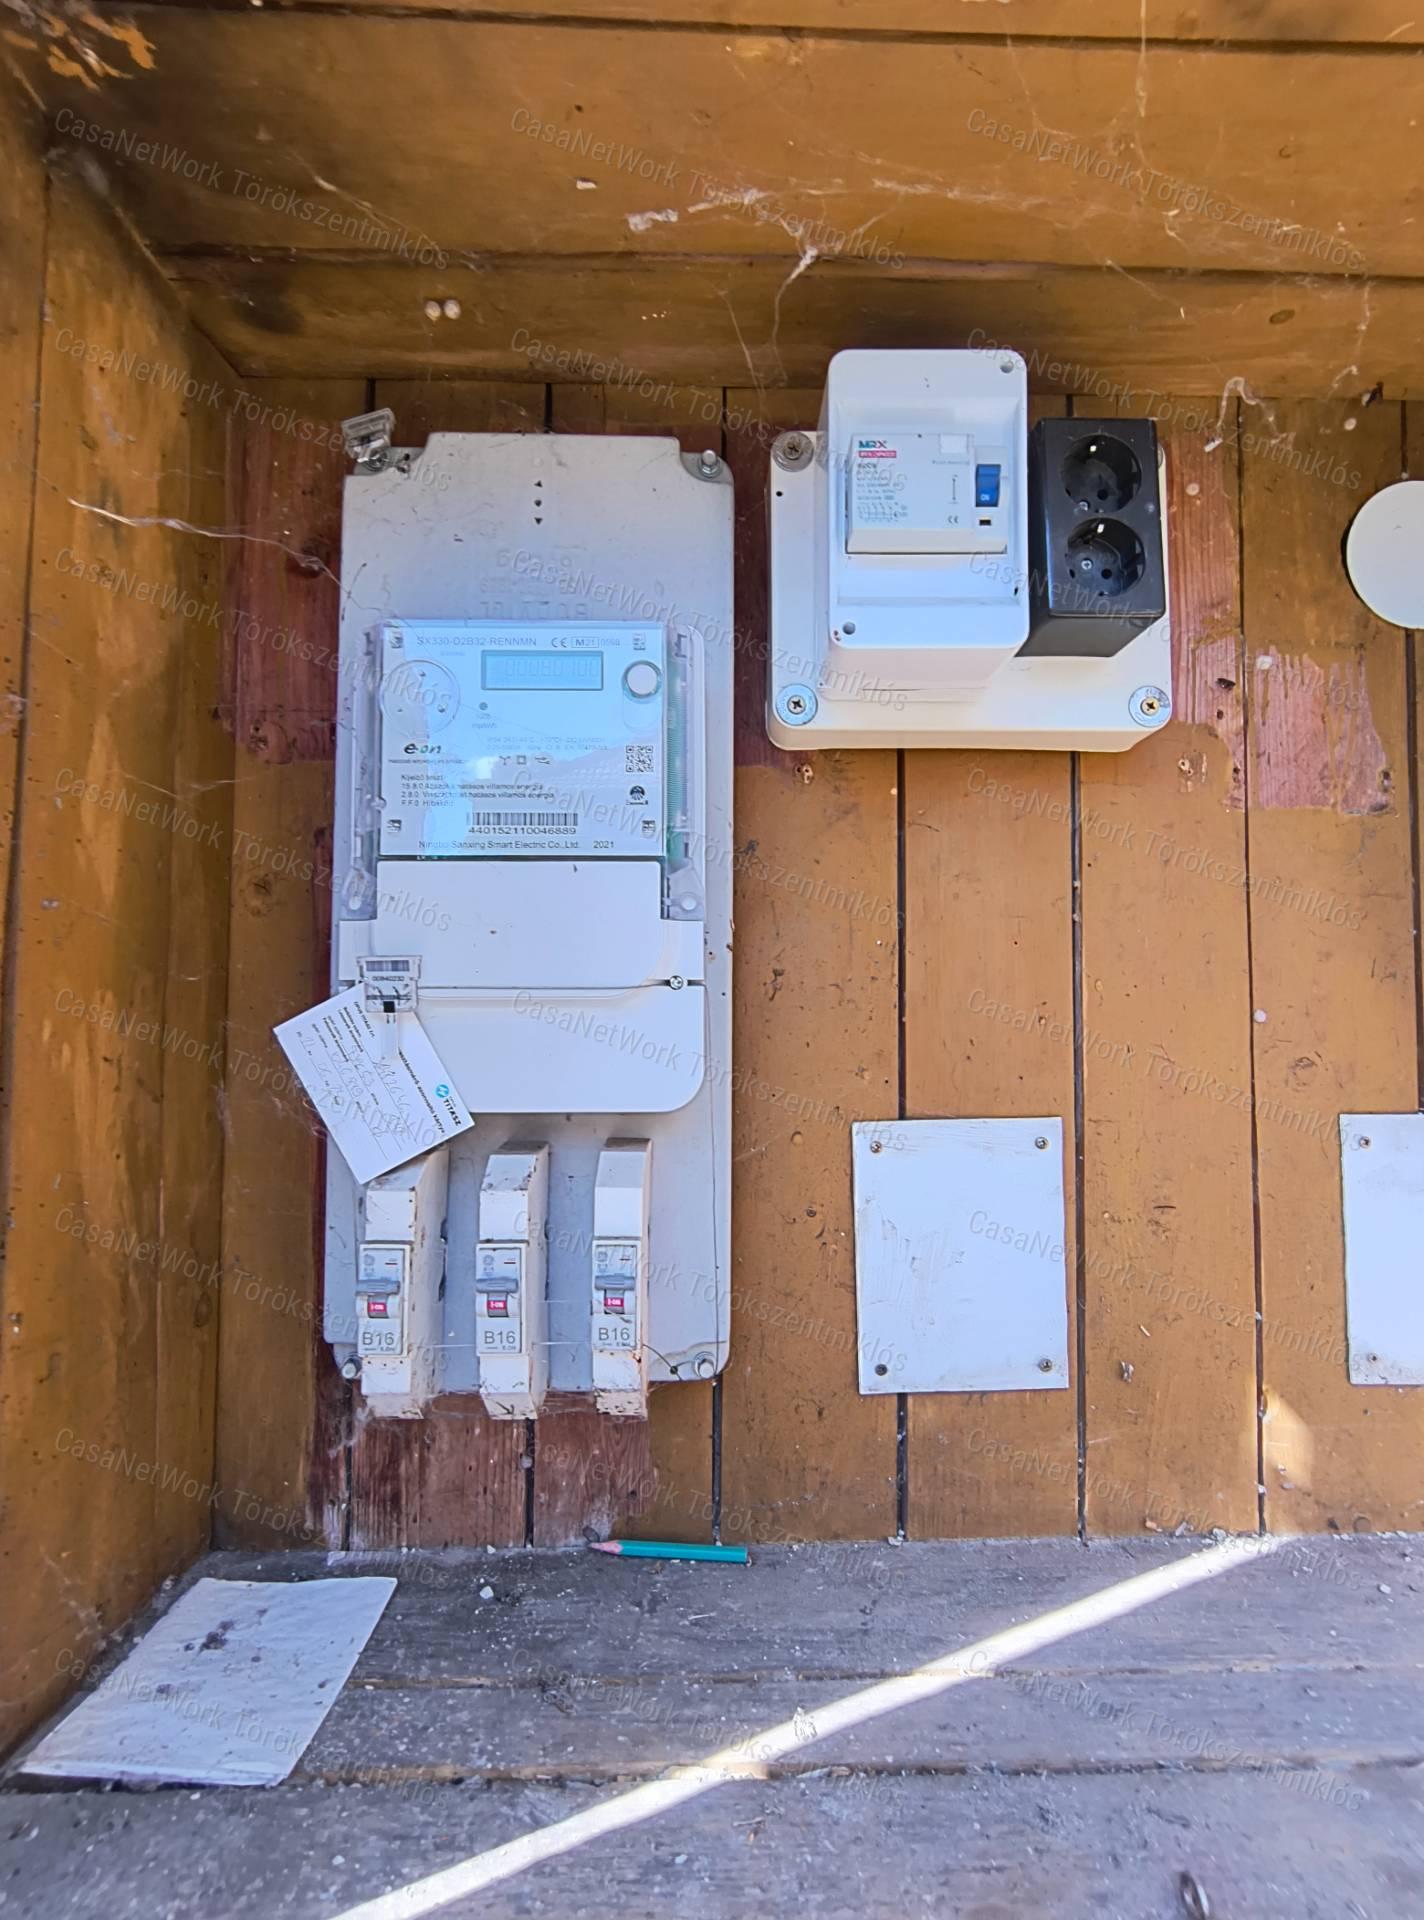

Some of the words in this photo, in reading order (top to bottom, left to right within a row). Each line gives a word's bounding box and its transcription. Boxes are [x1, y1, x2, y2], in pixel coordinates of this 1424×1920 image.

[452, 840, 486, 850] Sanxing
[488, 840, 513, 849] Smart
[515, 840, 547, 849] Electric
[593, 840, 614, 849] 2021
[362, 1331, 394, 1345] B16
[484, 1330, 516, 1344] B16
[599, 1327, 630, 1341] B16
